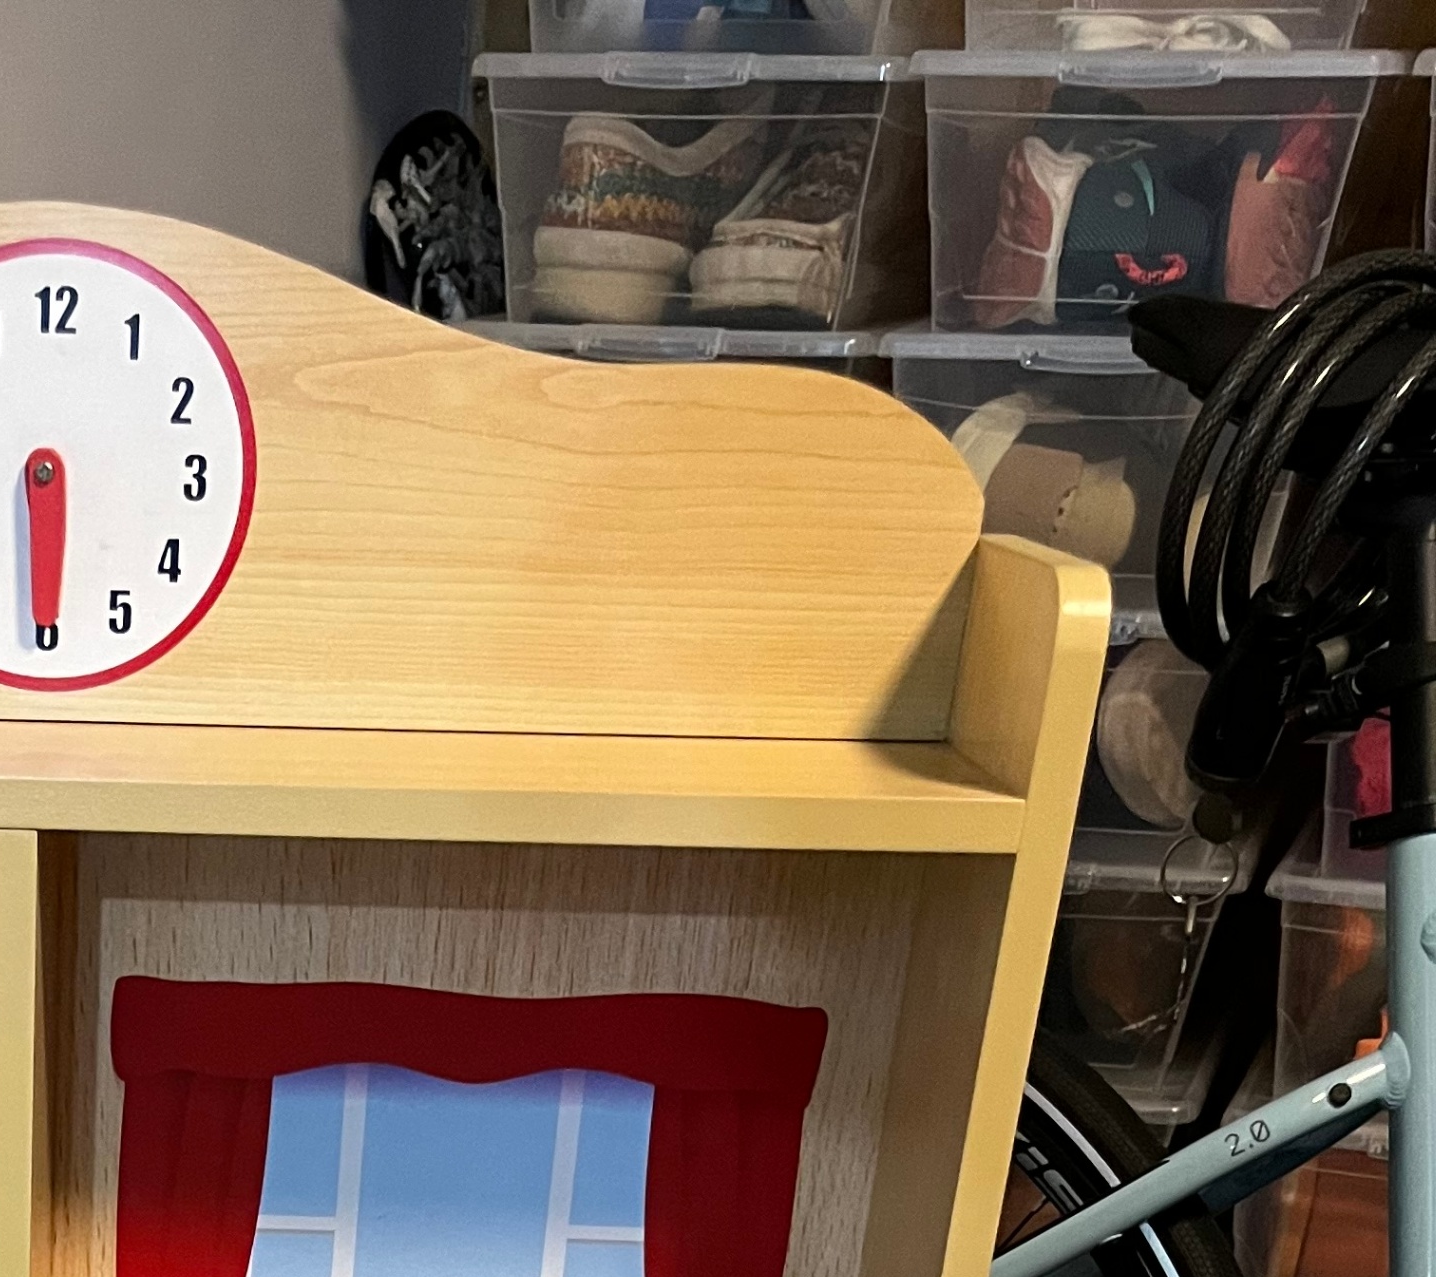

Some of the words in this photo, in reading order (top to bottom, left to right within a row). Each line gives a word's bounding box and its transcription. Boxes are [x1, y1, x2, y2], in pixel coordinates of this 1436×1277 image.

[35, 285, 79, 334] 12
[124, 313, 140, 360] 1
[170, 376, 194, 425] 2
[183, 454, 207, 502] 3
[157, 538, 182, 583] 4
[108, 589, 132, 634] 5
[1224, 1120, 1271, 1157] 2.0
